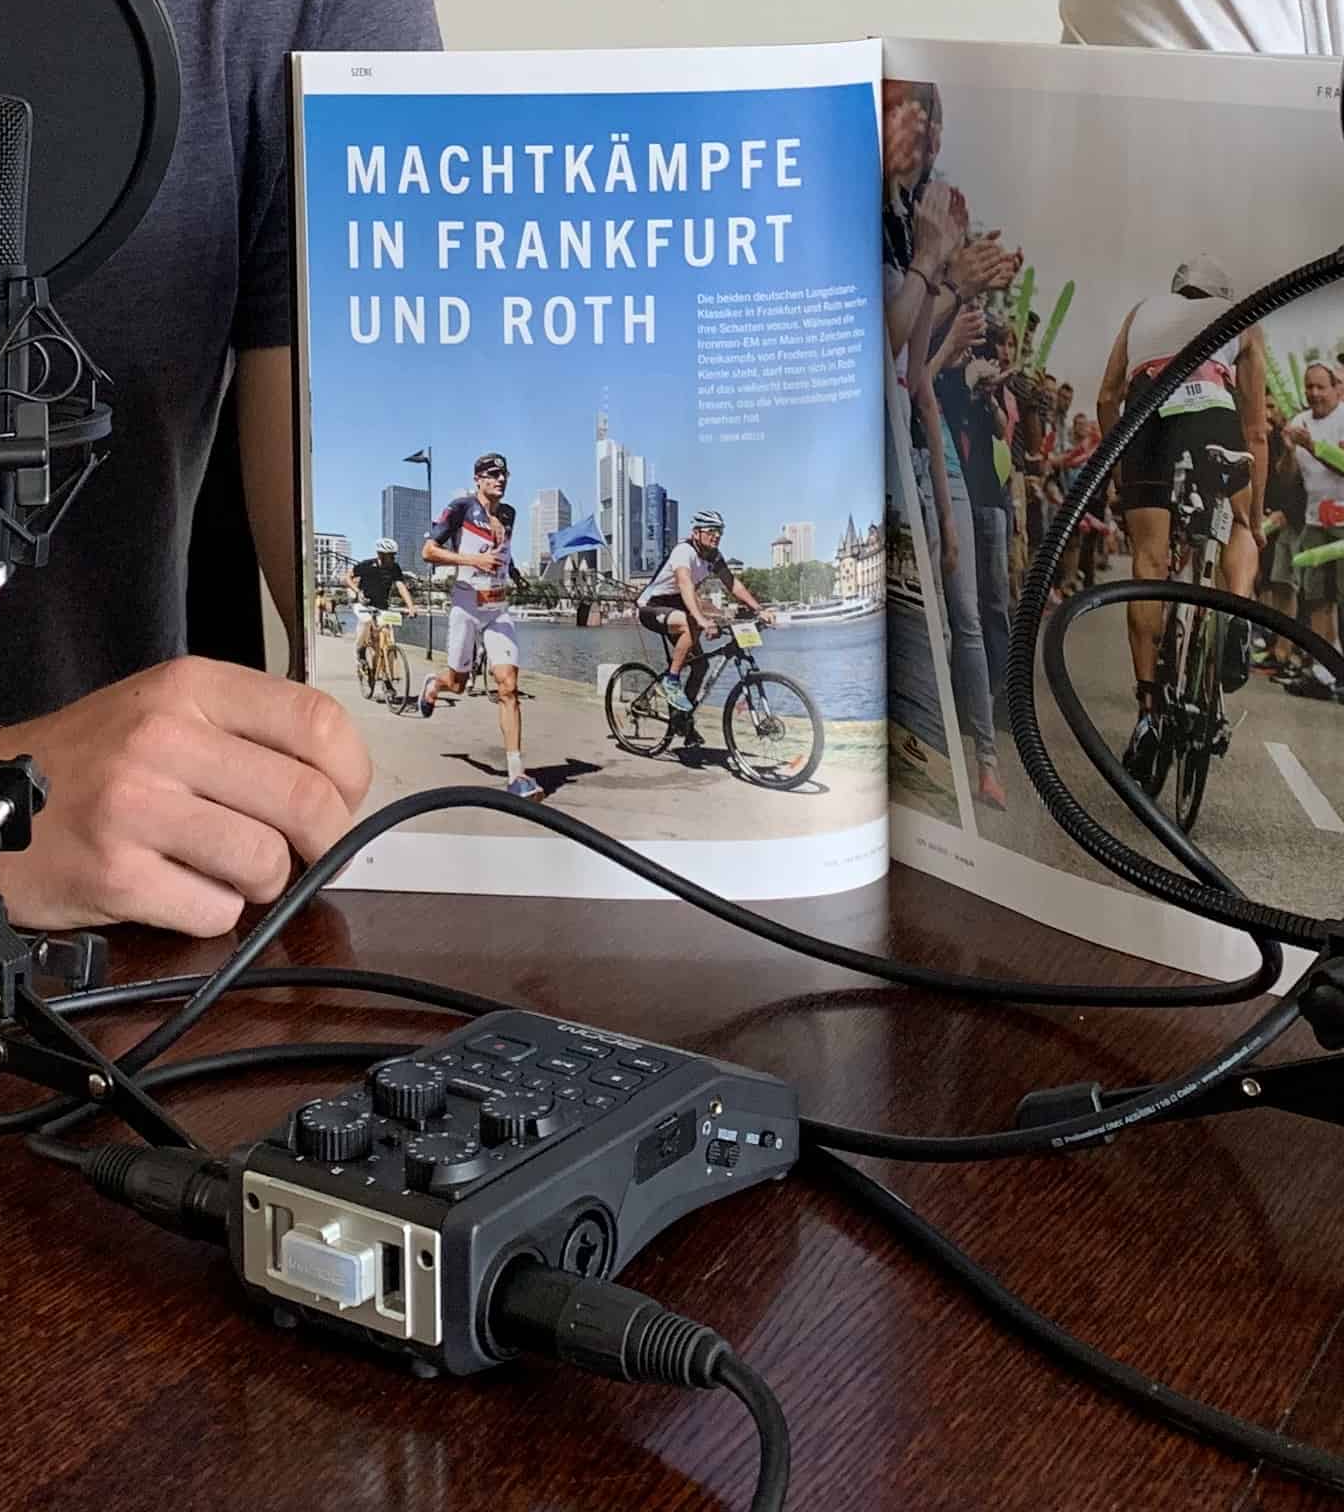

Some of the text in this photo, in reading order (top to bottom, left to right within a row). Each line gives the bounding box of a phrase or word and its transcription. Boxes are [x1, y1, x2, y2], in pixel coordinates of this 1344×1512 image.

[346, 133, 803, 194] MACHTKÄMPFE
[348, 214, 793, 269] IN FRANKFURT
[698, 294, 715, 305] Die
[716, 293, 750, 303] beiden
[753, 289, 804, 302] deutschen
[350, 295, 656, 345] UND ROTH
[758, 305, 801, 316] Frankfurt
[719, 322, 764, 334] Schatten
[698, 414, 741, 427] gesehen
[557, 1024, 643, 1050] ZOOM
